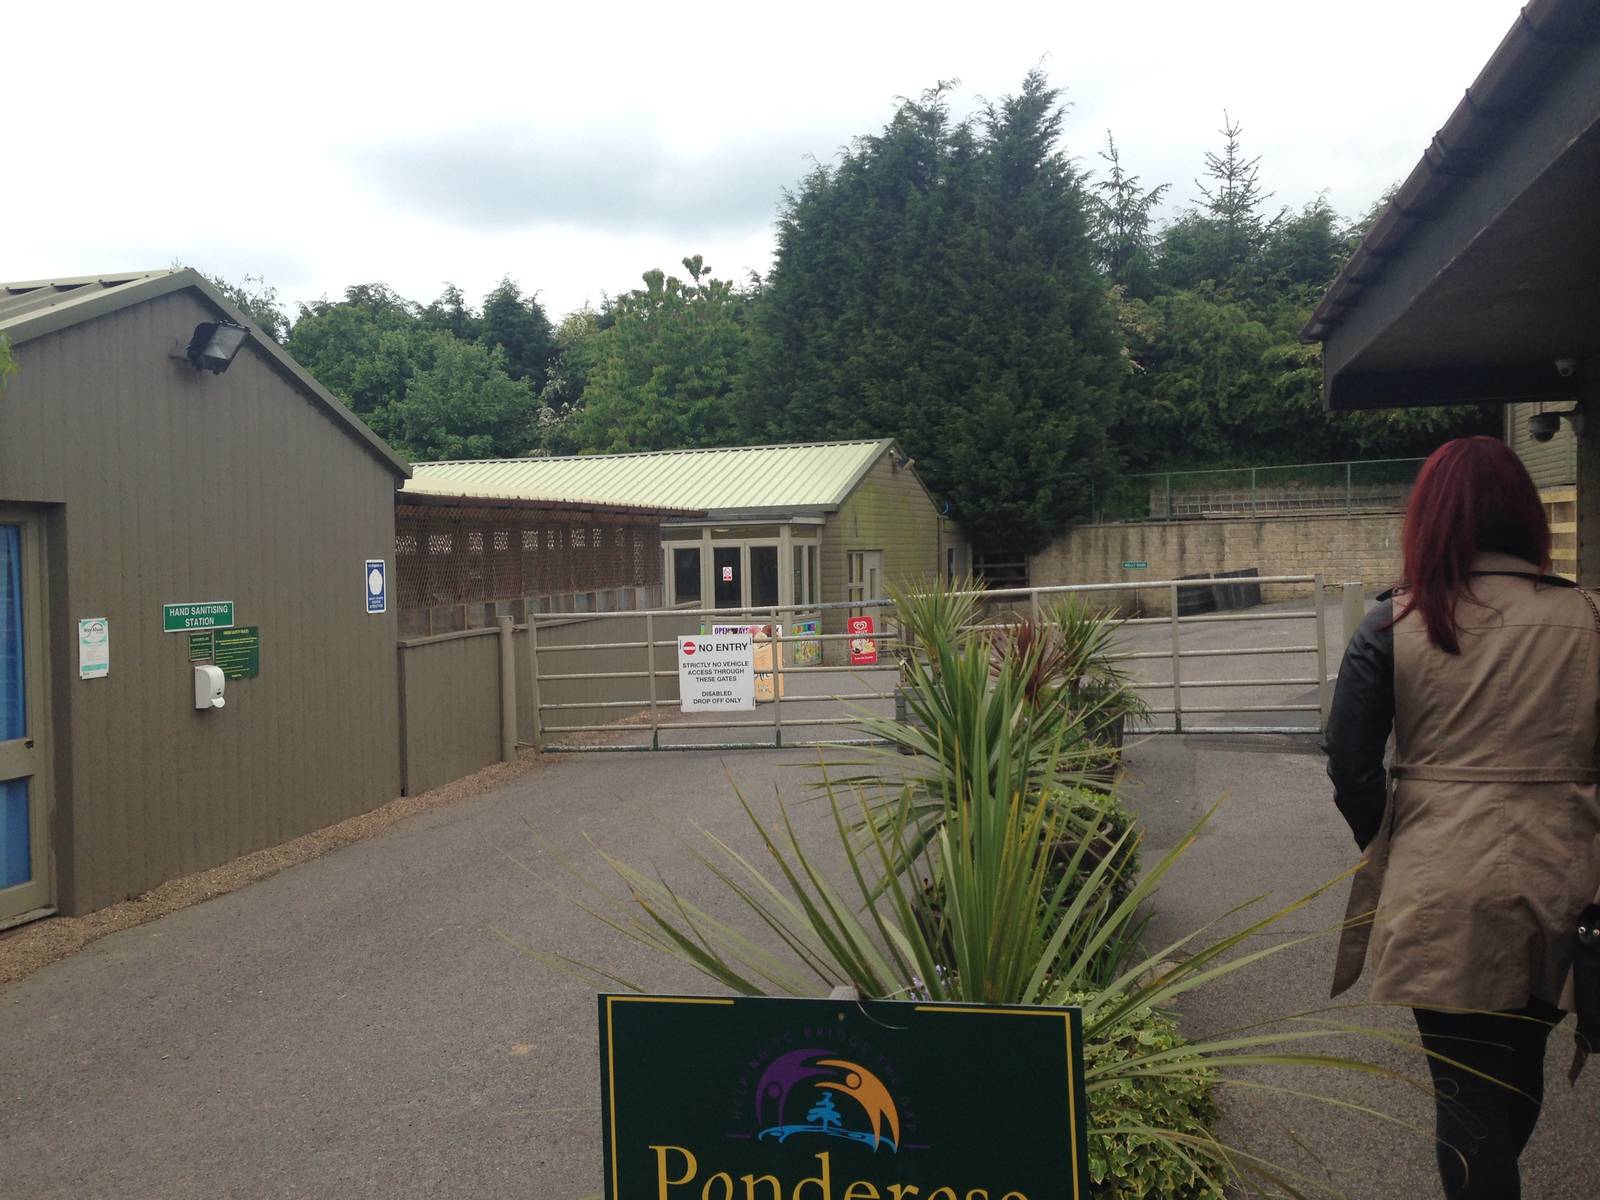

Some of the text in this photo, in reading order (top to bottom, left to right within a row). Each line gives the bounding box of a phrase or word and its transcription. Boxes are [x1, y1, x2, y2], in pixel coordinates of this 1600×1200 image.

[169, 605, 228, 616] HAND SANITISING
[185, 617, 214, 627] STATION
[699, 643, 713, 652] NO
[716, 643, 748, 652] ENTRY
[648, 1145, 1030, 1200] Ponder
